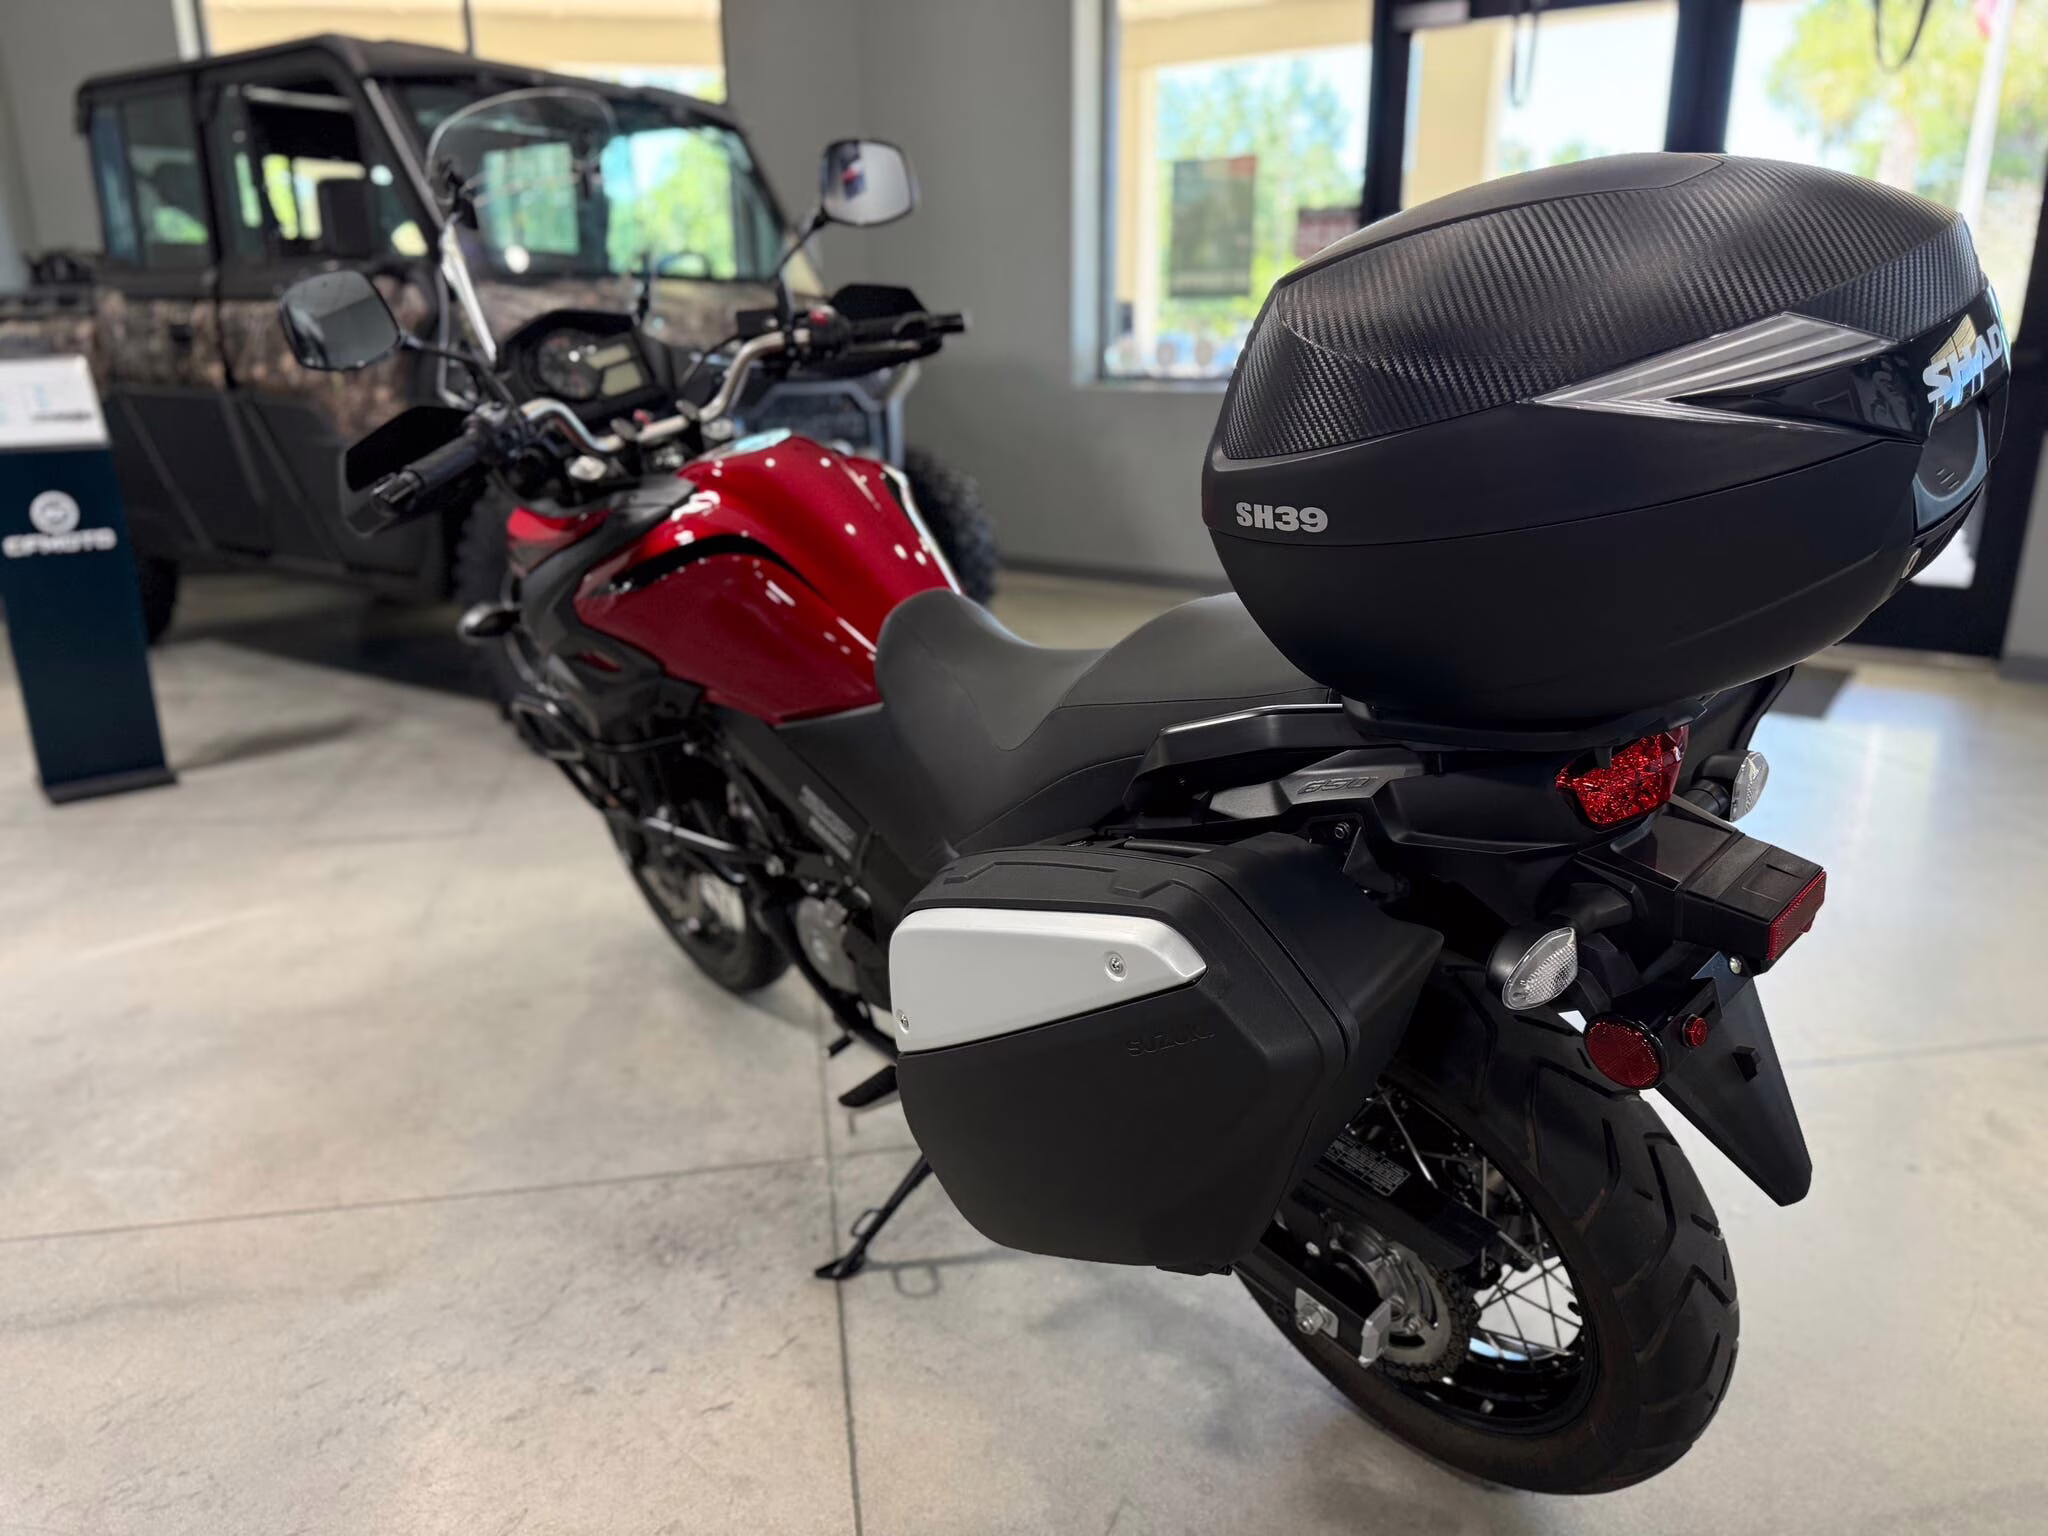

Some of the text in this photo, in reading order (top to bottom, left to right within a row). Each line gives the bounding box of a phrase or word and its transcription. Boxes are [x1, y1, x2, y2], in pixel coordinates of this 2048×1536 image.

[1923, 323, 2003, 404] SHAD
[1236, 502, 1328, 533] SH39
[1296, 775, 1374, 795] 650
[1126, 1024, 1217, 1057] SUZUKI
